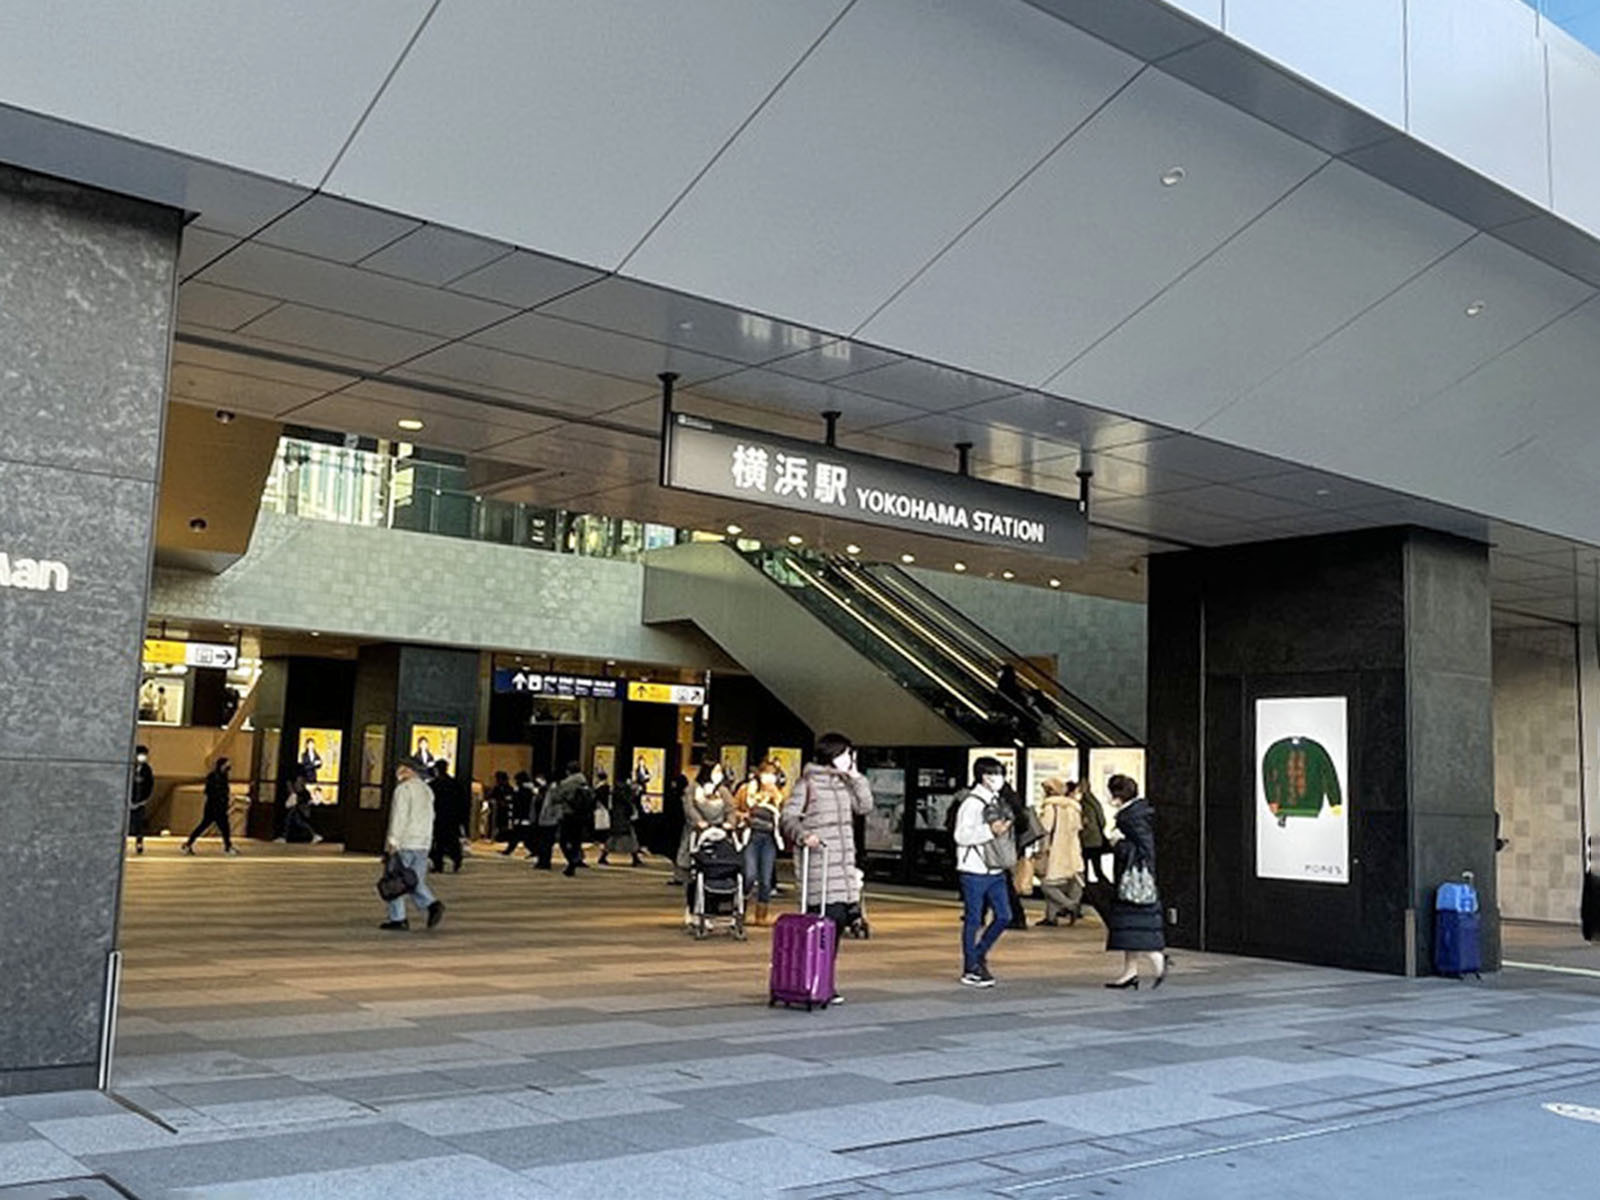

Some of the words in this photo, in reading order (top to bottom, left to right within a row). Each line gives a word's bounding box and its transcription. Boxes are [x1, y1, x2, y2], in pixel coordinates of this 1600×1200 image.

[731, 444, 849, 507] 横浜駅
[856, 487, 969, 530] YOKOHAMA
[971, 511, 1045, 544] STATION
